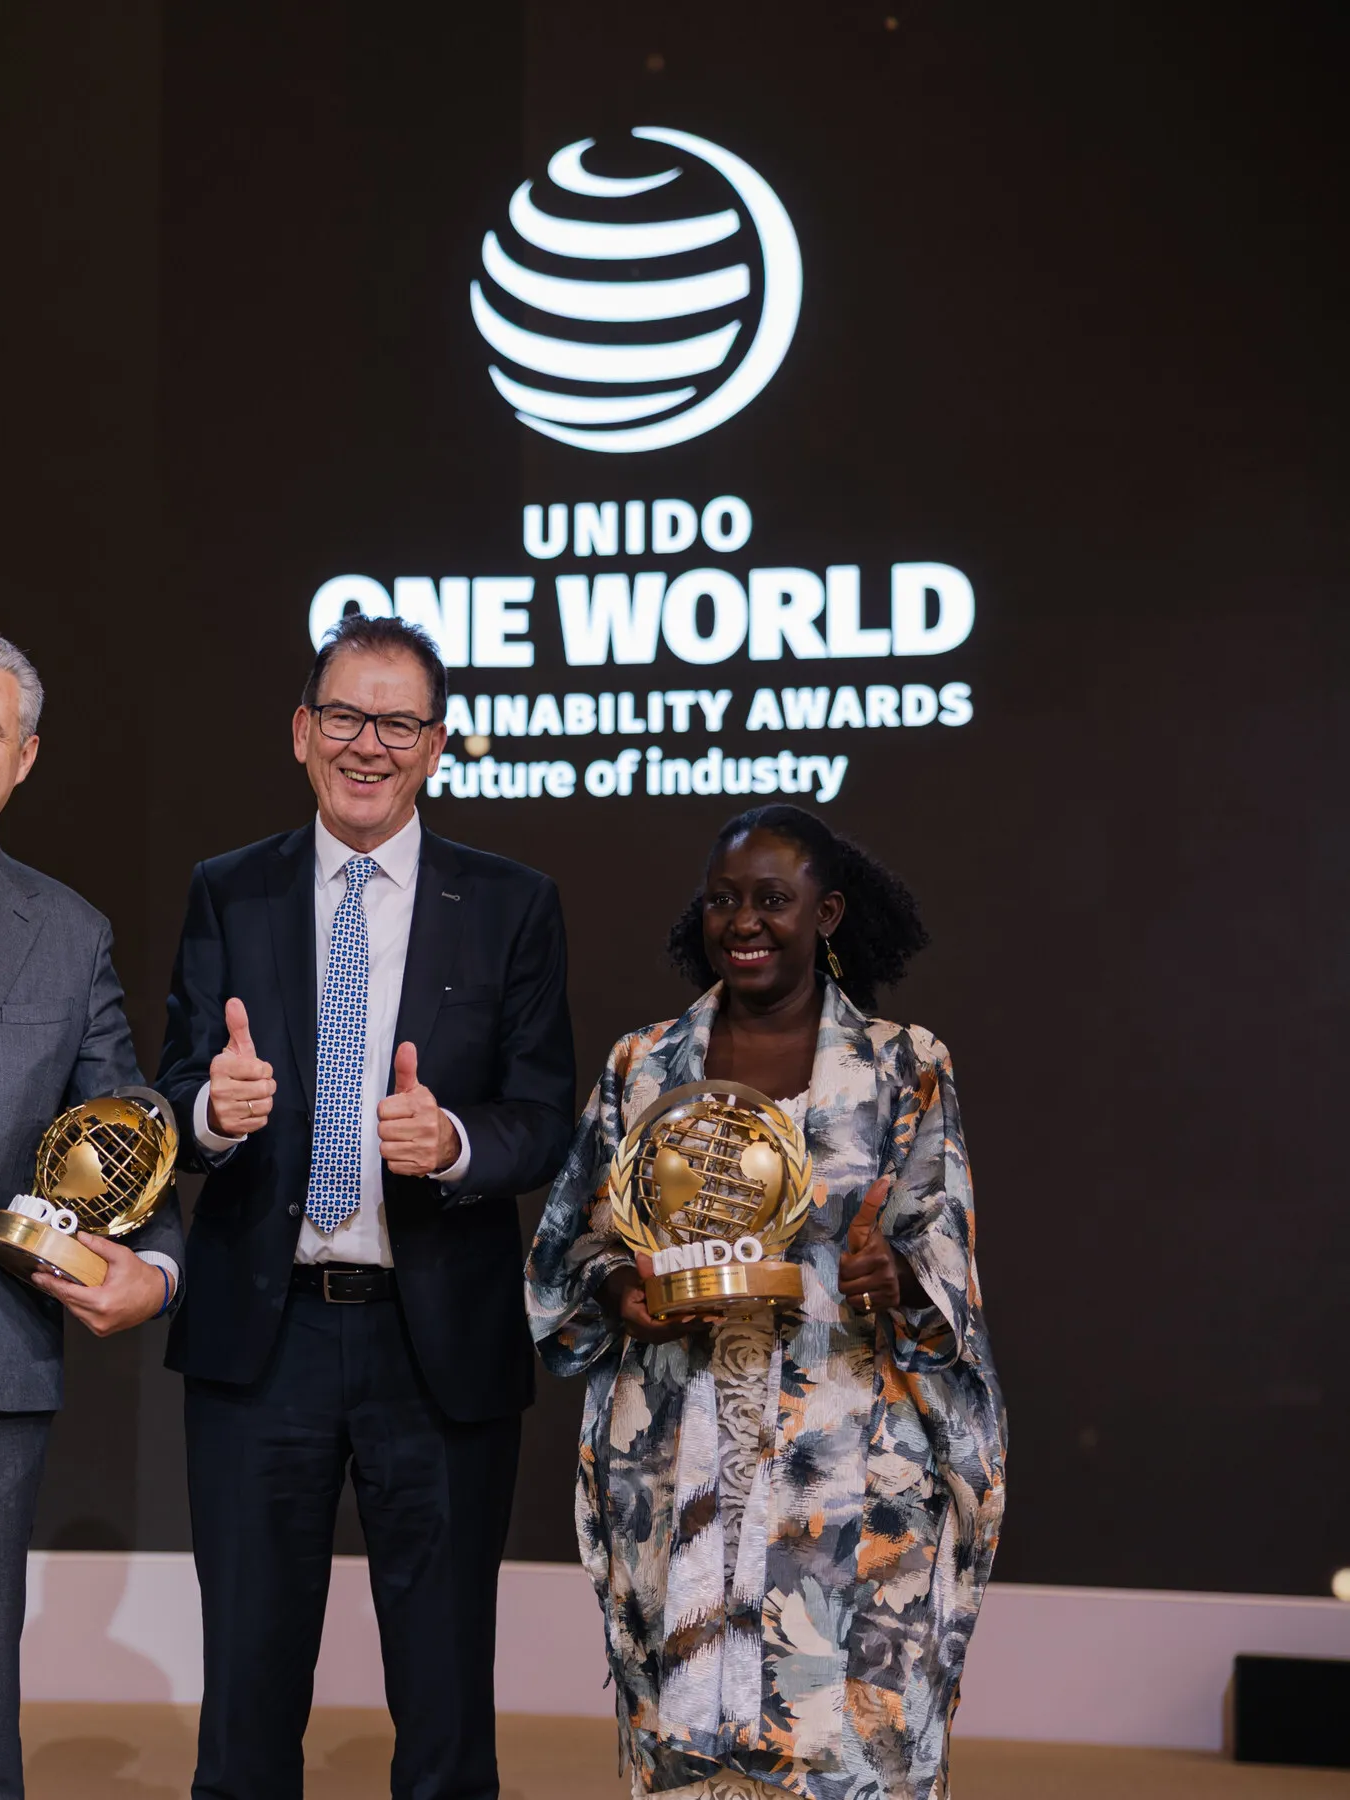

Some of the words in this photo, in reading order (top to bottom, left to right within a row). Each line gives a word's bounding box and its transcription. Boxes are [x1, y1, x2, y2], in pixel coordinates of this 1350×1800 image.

[523, 495, 752, 560] UNIDO
[555, 561, 976, 667] WORLD
[444, 689, 733, 738] AINABILITY
[745, 682, 975, 733] AWARDS
[426, 752, 577, 799] Future
[584, 748, 643, 798] of
[645, 746, 849, 804] industry
